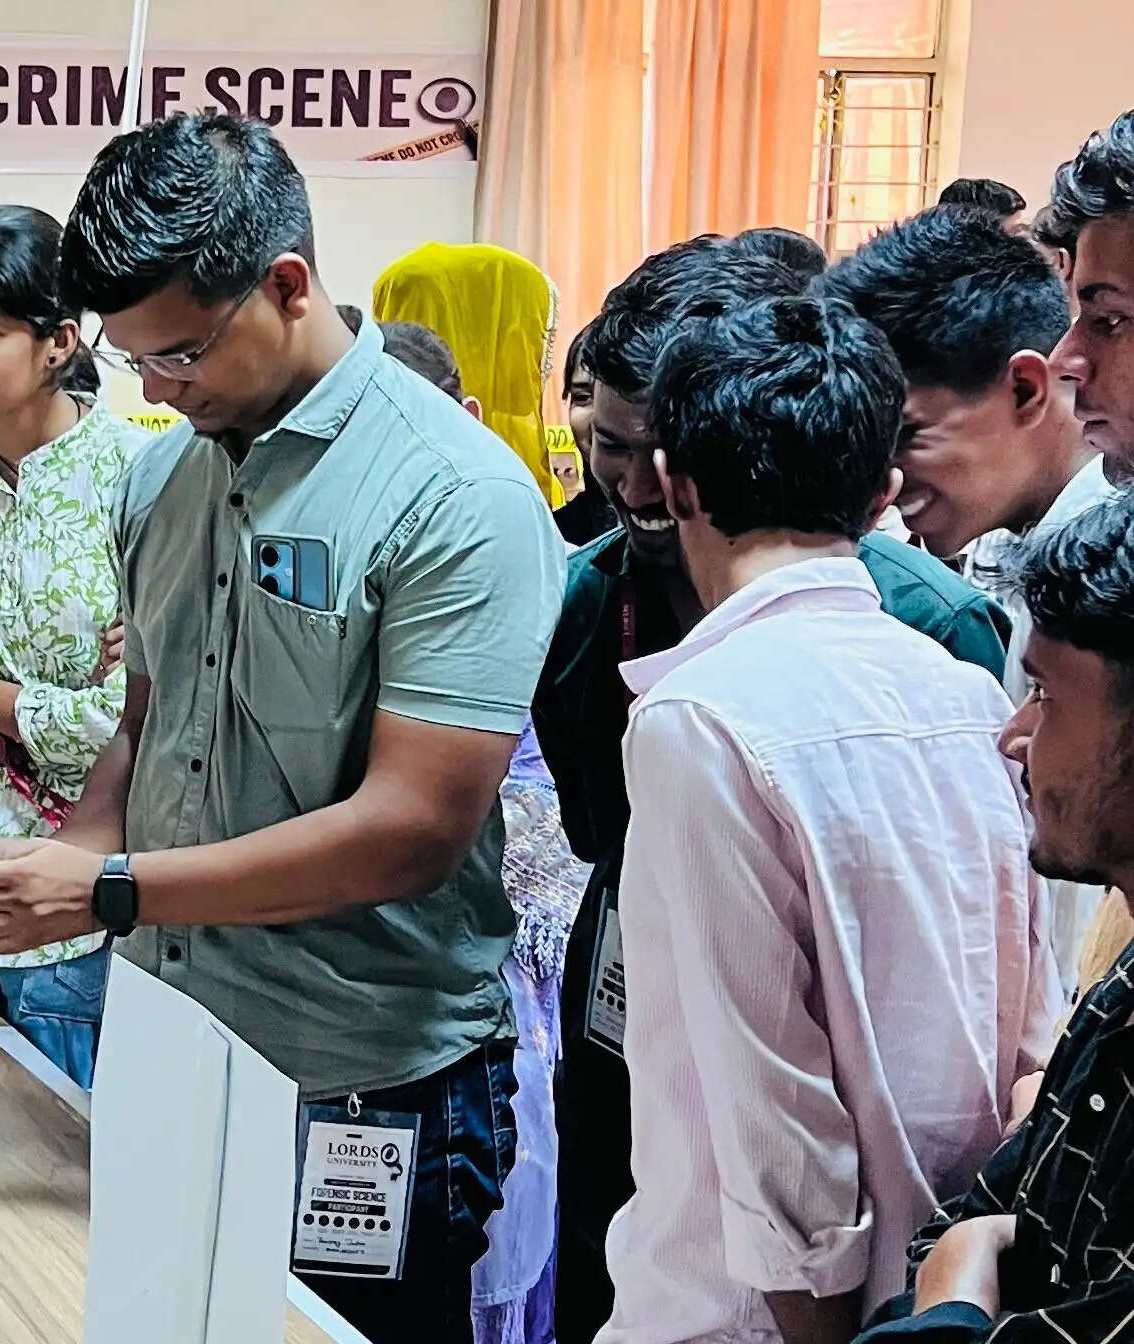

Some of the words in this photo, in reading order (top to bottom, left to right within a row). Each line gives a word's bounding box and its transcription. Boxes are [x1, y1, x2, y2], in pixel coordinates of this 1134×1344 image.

[204, 66, 412, 128] SCENE
[398, 146, 416, 160] DO
[415, 138, 439, 154] NOT
[439, 131, 462, 145] CRO
[327, 1142, 379, 1158] LORDS
[326, 1157, 377, 1168] UNIVERSITY
[311, 1187, 351, 1200] FORENSIC
[353, 1190, 386, 1203] SCIENCE
